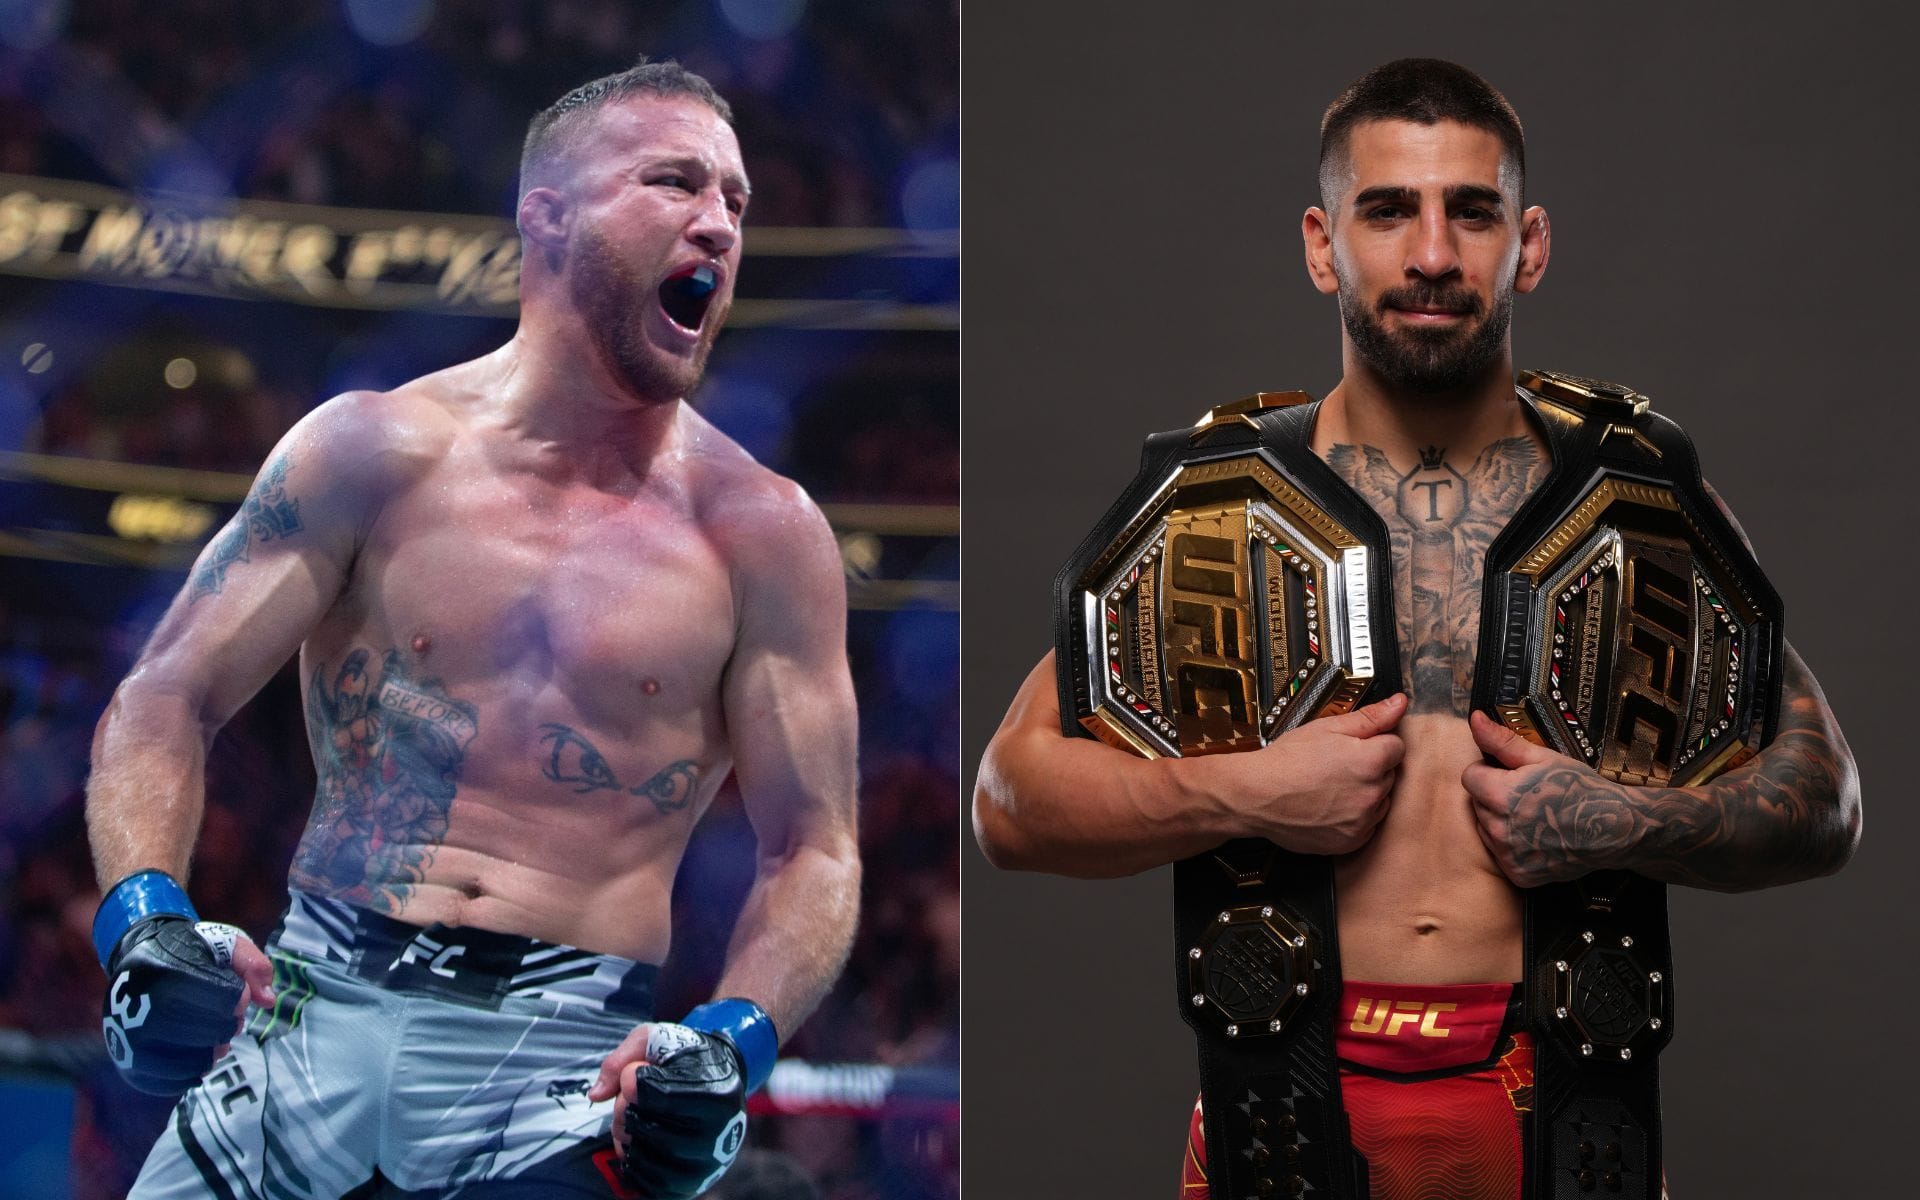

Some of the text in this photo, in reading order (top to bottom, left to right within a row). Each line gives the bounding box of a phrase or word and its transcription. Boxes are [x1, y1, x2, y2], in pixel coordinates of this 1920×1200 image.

[1412, 480, 1452, 522] T
[1141, 580, 1158, 703] CHAMPION
[1172, 533, 1248, 724] UFC
[1269, 577, 1285, 670] WORLD
[1578, 590, 1600, 719] CHAMPION
[1620, 556, 1687, 755] UFC
[383, 688, 469, 737] BEFORE
[1696, 630, 1714, 723] WORLD
[389, 934, 466, 978] FC
[1350, 998, 1457, 1037] UFC
